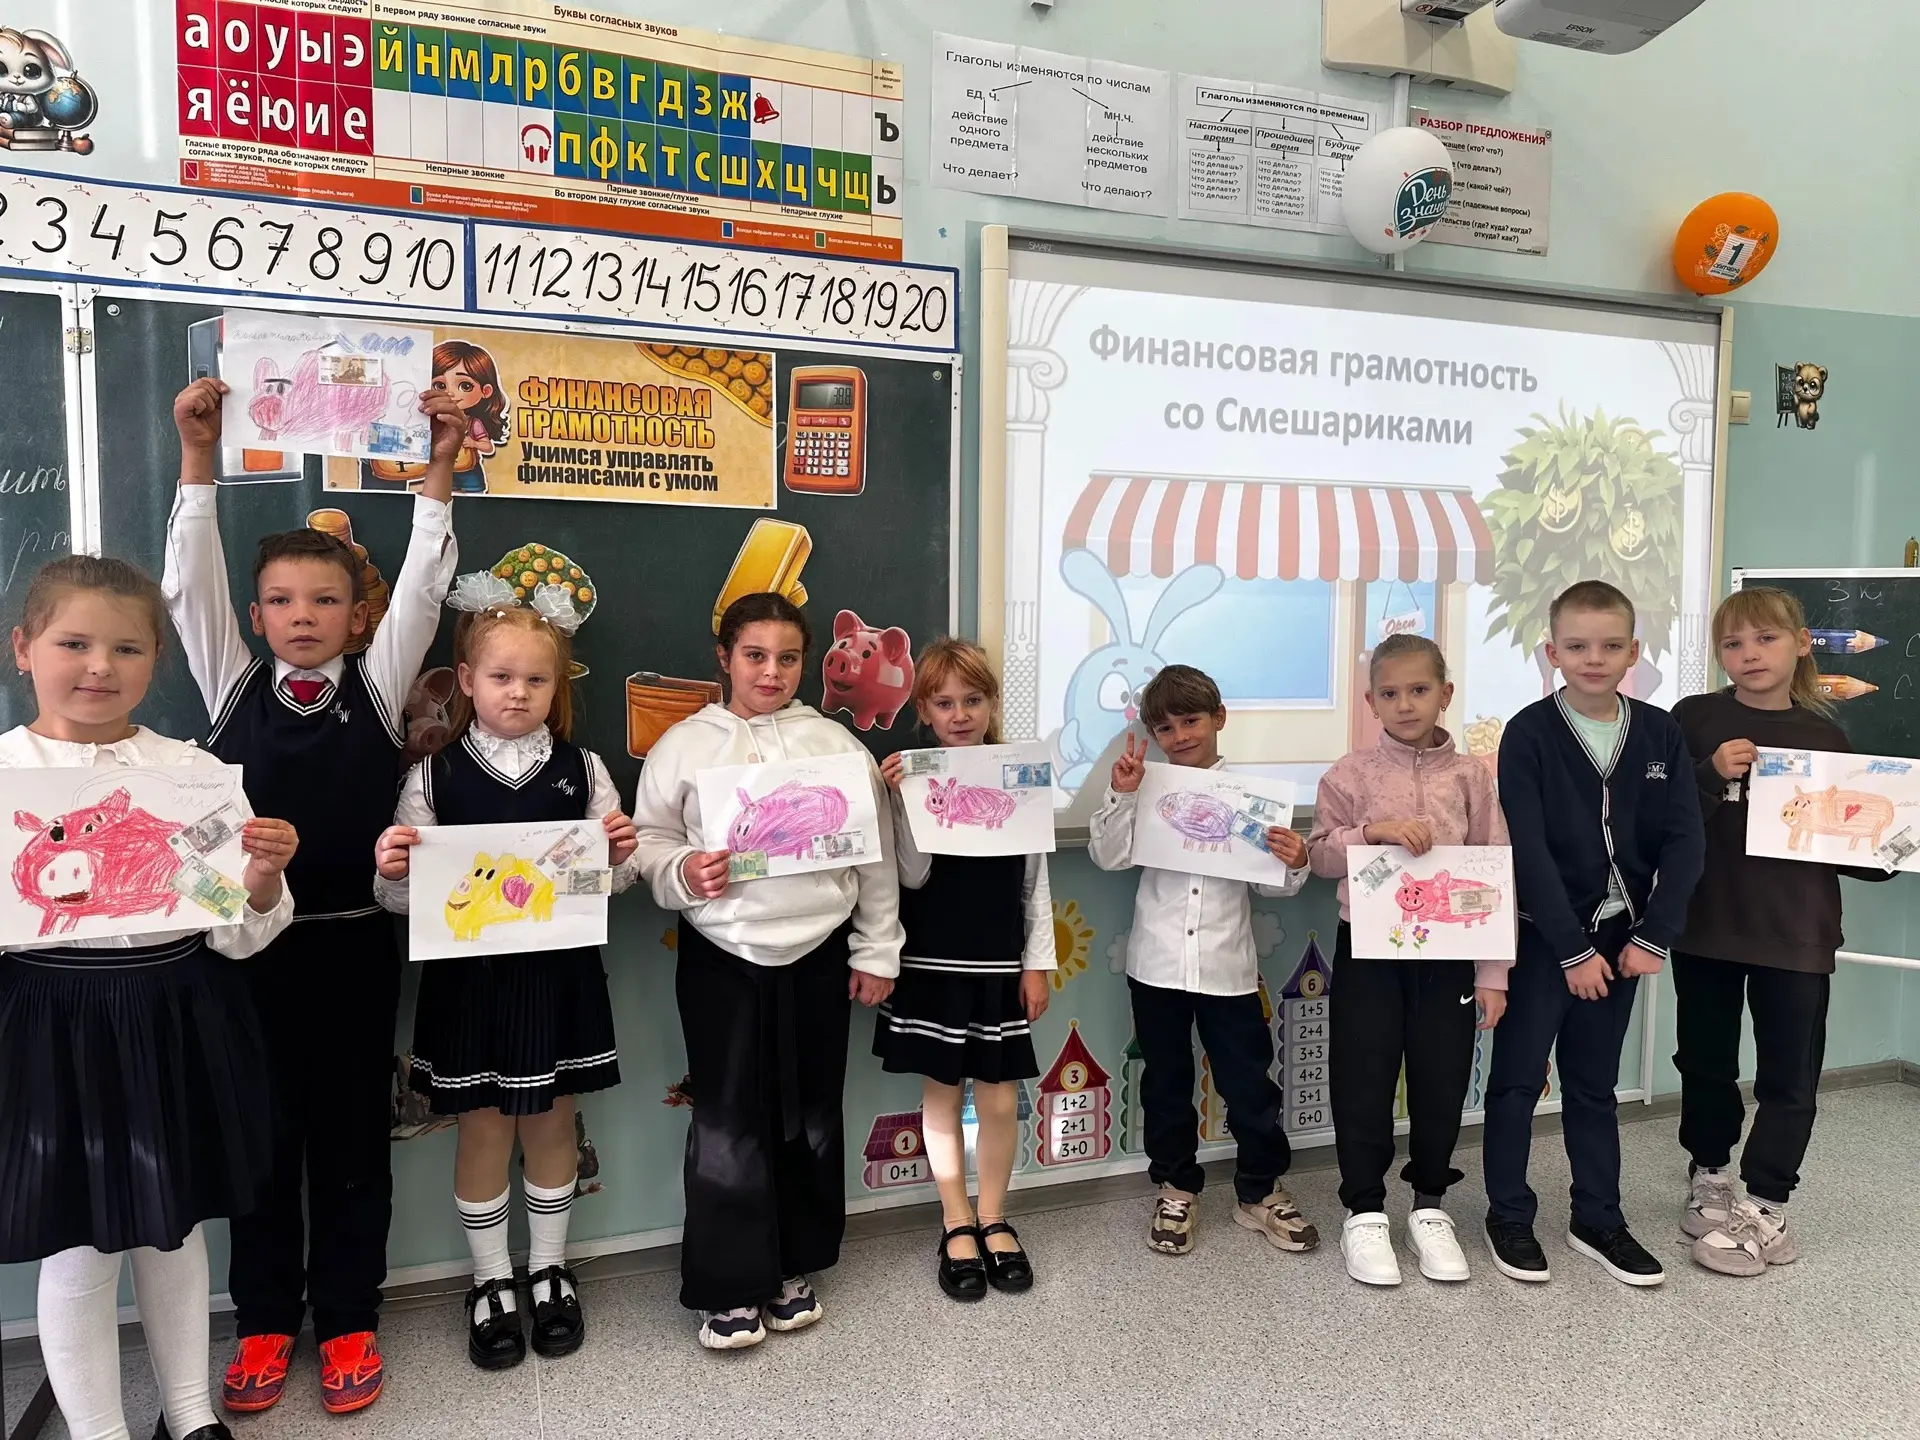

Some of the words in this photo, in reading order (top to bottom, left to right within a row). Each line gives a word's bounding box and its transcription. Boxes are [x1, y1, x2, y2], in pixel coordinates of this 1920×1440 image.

[383, 6, 416, 19] первом
[418, 11, 439, 23] ряду
[442, 14, 475, 25] звонкие
[477, 18, 520, 31] согласные
[522, 23, 547, 35] звуки
[553, 5, 587, 21] Буквы
[589, 12, 642, 31] согласных
[645, 21, 678, 37] звуков
[1565, 23, 1596, 34] EPSON
[184, 14, 210, 49] а
[224, 18, 250, 53] о
[264, 23, 290, 71] у
[299, 28, 332, 65] ы
[343, 32, 365, 68] э
[379, 25, 403, 73] й
[415, 42, 440, 78] н
[449, 47, 480, 83] м
[489, 51, 514, 88] л
[524, 56, 547, 102] р
[558, 52, 581, 97] б
[593, 67, 615, 101] в
[630, 73, 646, 104] г
[658, 78, 683, 120] д
[694, 85, 712, 116] з
[721, 89, 747, 121] ж
[945, 50, 1002, 70] Глаголы
[1006, 62, 1084, 83] изменяются
[1087, 74, 1102, 86] по
[1106, 77, 1151, 94] числам
[1201, 91, 1244, 104] Глаголы
[1246, 97, 1304, 112] изменяются
[1306, 106, 1318, 114] по
[1319, 108, 1365, 122] временам
[951, 110, 1008, 126] действие
[959, 124, 1001, 138] одного
[1189, 121, 1250, 135] Настоящее
[1420, 117, 1463, 132] РАЗБОР
[1466, 124, 1546, 146] ПРЕДЛОЖЕНИЯ
[187, 87, 212, 122] я
[226, 78, 251, 126] ё
[261, 95, 295, 132] ю
[305, 101, 328, 136] и
[343, 107, 367, 141] е
[559, 131, 581, 165] п
[589, 125, 618, 179] ф
[627, 140, 648, 173] к
[661, 145, 681, 177] т
[694, 150, 710, 182] с
[721, 154, 748, 186] ш
[756, 158, 775, 190] х
[785, 163, 807, 202] ц
[817, 168, 837, 198] ч
[844, 170, 869, 209] щ
[950, 135, 1009, 152] предмета
[1092, 132, 1144, 149] действие
[1203, 133, 1235, 143] время
[1256, 130, 1314, 144] Прошедшее
[185, 138, 220, 150] Гласные
[222, 143, 256, 154] второго
[258, 147, 279, 157] ряда
[281, 150, 330, 162] обозначают
[332, 156, 369, 168] мягкость
[1086, 145, 1149, 162] нескольких
[1270, 142, 1299, 152] время
[188, 148, 232, 159] согласных
[267, 156, 292, 166] после
[294, 160, 330, 171] которых
[331, 164, 366, 175] следуют
[1087, 157, 1148, 175] предметов
[425, 163, 469, 176] Непарные
[471, 169, 505, 180] звонкие
[942, 162, 966, 175] Что
[968, 166, 1019, 181] делает?
[607, 183, 637, 196] Парные
[639, 188, 699, 203] звонкие/глухие
[1081, 181, 1102, 192] Что
[1103, 185, 1153, 199] делают?
[1405, 178, 1447, 207] День
[554, 189, 565, 198] Во
[567, 191, 596, 203] втором
[599, 195, 617, 207] ряду
[618, 198, 646, 209] глухие
[648, 201, 687, 213] согласные
[688, 206, 710, 216] звуки
[781, 205, 817, 218] Непарные
[819, 211, 843, 221] глухие
[32, 196, 68, 253] 3
[90, 203, 125, 261] 4
[150, 209, 187, 265] 5
[208, 217, 244, 271] 6
[260, 220, 294, 275] 7
[309, 226, 343, 281] 8
[359, 232, 392, 285] 9
[406, 236, 455, 291] 10
[1728, 243, 1745, 266] 1
[484, 243, 521, 295] 11
[528, 246, 571, 298] 12
[582, 250, 622, 302] 13
[632, 256, 671, 308] 14
[680, 262, 721, 312] 15
[728, 266, 766, 317] 16
[775, 271, 814, 321] 17
[820, 275, 856, 325] 18
[861, 279, 897, 328] 19
[899, 283, 947, 332] 20
[1089, 324, 1318, 376] Финансовая
[1329, 349, 1538, 394] грамотность
[518, 376, 712, 420] ФИНАНСОВАЯ
[517, 408, 716, 449] ГРАМОТНОСТЬ
[1164, 400, 1205, 430] со
[1216, 398, 1473, 446] Смешариками
[521, 441, 602, 467] Учимся
[606, 449, 714, 473] управлять
[516, 462, 645, 489] финансами
[649, 472, 661, 488] с
[665, 473, 718, 493] умом
[1308, 978, 1316, 992] 6
[1300, 1003, 1324, 1017] 1+5
[1300, 1024, 1323, 1038] 2+4
[1300, 1045, 1323, 1060] 3+3
[1070, 1070, 1080, 1084] 3
[1299, 1067, 1323, 1081] 4+2
[1061, 1095, 1087, 1110] 1+2
[1299, 1088, 1321, 1103] 5+1
[1061, 1119, 1087, 1133] 2+1
[1298, 1110, 1322, 1125] 6+0
[902, 1136, 909, 1150] 1
[1061, 1141, 1088, 1157] 3+0
[890, 1164, 918, 1180] 0+1
